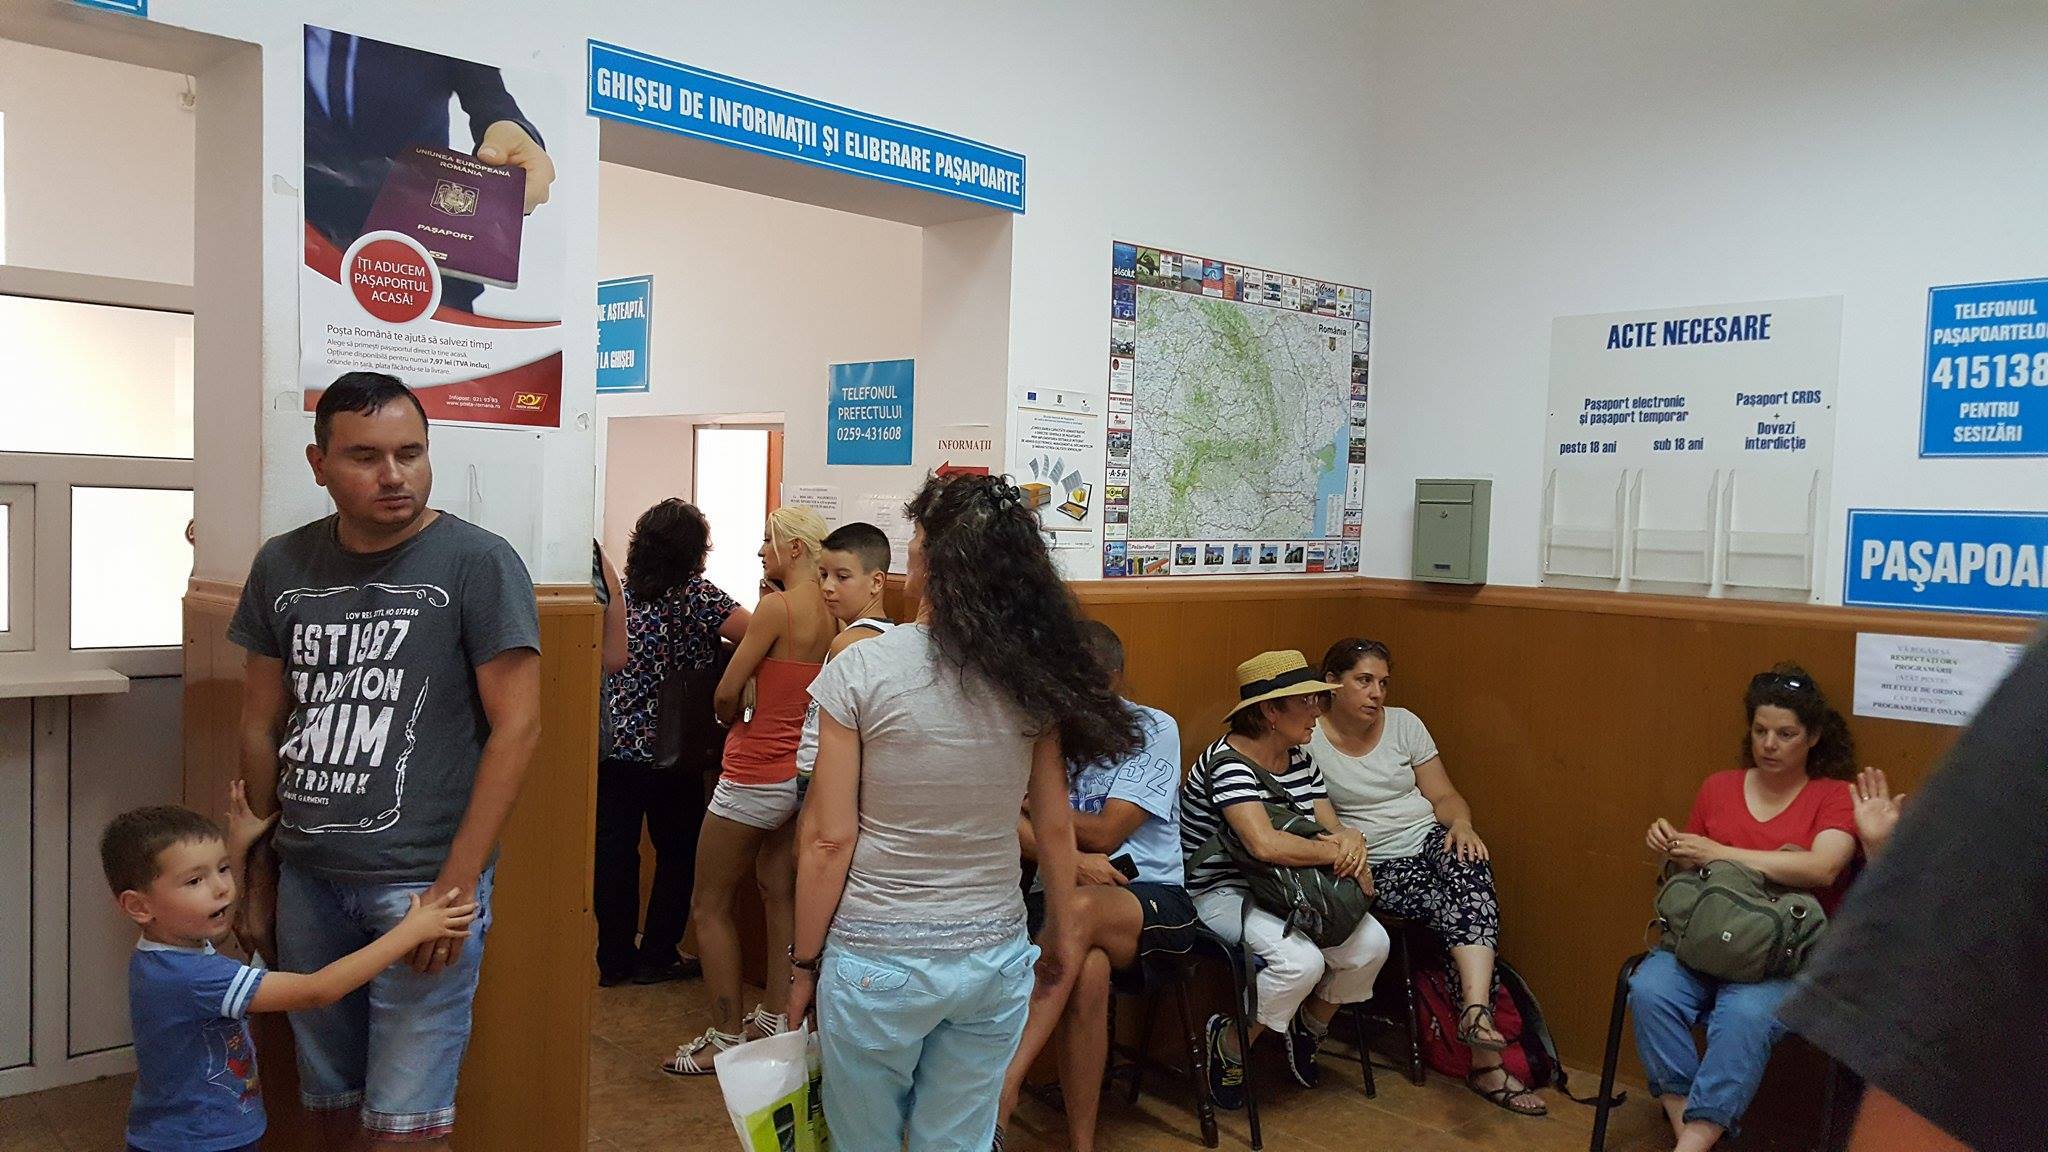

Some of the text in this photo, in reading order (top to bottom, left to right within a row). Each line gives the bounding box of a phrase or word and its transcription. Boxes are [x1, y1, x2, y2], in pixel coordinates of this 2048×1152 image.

[679, 88, 704, 120] DE
[845, 131, 931, 174] ELIBERARE
[416, 148, 454, 162] UNIUNEA
[374, 260, 425, 277] ADUCEM
[371, 290, 413, 305] ACASĂ!
[1954, 299, 2037, 320] TELEFONUL
[1318, 323, 1347, 336] România
[1606, 313, 1772, 349] ACTE NECESARE
[327, 338, 346, 348] Alege
[354, 327, 392, 340] Română
[394, 332, 403, 341] te
[404, 333, 426, 343] ajută
[428, 336, 438, 345] să
[439, 337, 468, 347] salvezi
[470, 340, 493, 351] timp!
[388, 354, 409, 362] pentru
[429, 358, 443, 366] 7,97
[444, 358, 452, 366] lei
[453, 360, 468, 368] (TVA
[600, 352, 609, 369] LA
[842, 385, 898, 401] TELEFONUL
[1791, 390, 1821, 404] CRDS
[1632, 395, 1685, 409] electronic
[1959, 401, 2019, 418] PENTRU
[838, 405, 902, 421] PREFECTULUI
[1639, 410, 1689, 424] temporar
[836, 426, 902, 441] 0259-431608
[1757, 421, 1795, 435] Dovezi
[1953, 421, 2023, 442] SESIZĂRI
[1560, 441, 1617, 455] peste 18 ani
[1653, 437, 1704, 450] sub 18 ani
[1861, 539, 2048, 592] PAŞAPOA
[292, 619, 411, 666] EST 1987
